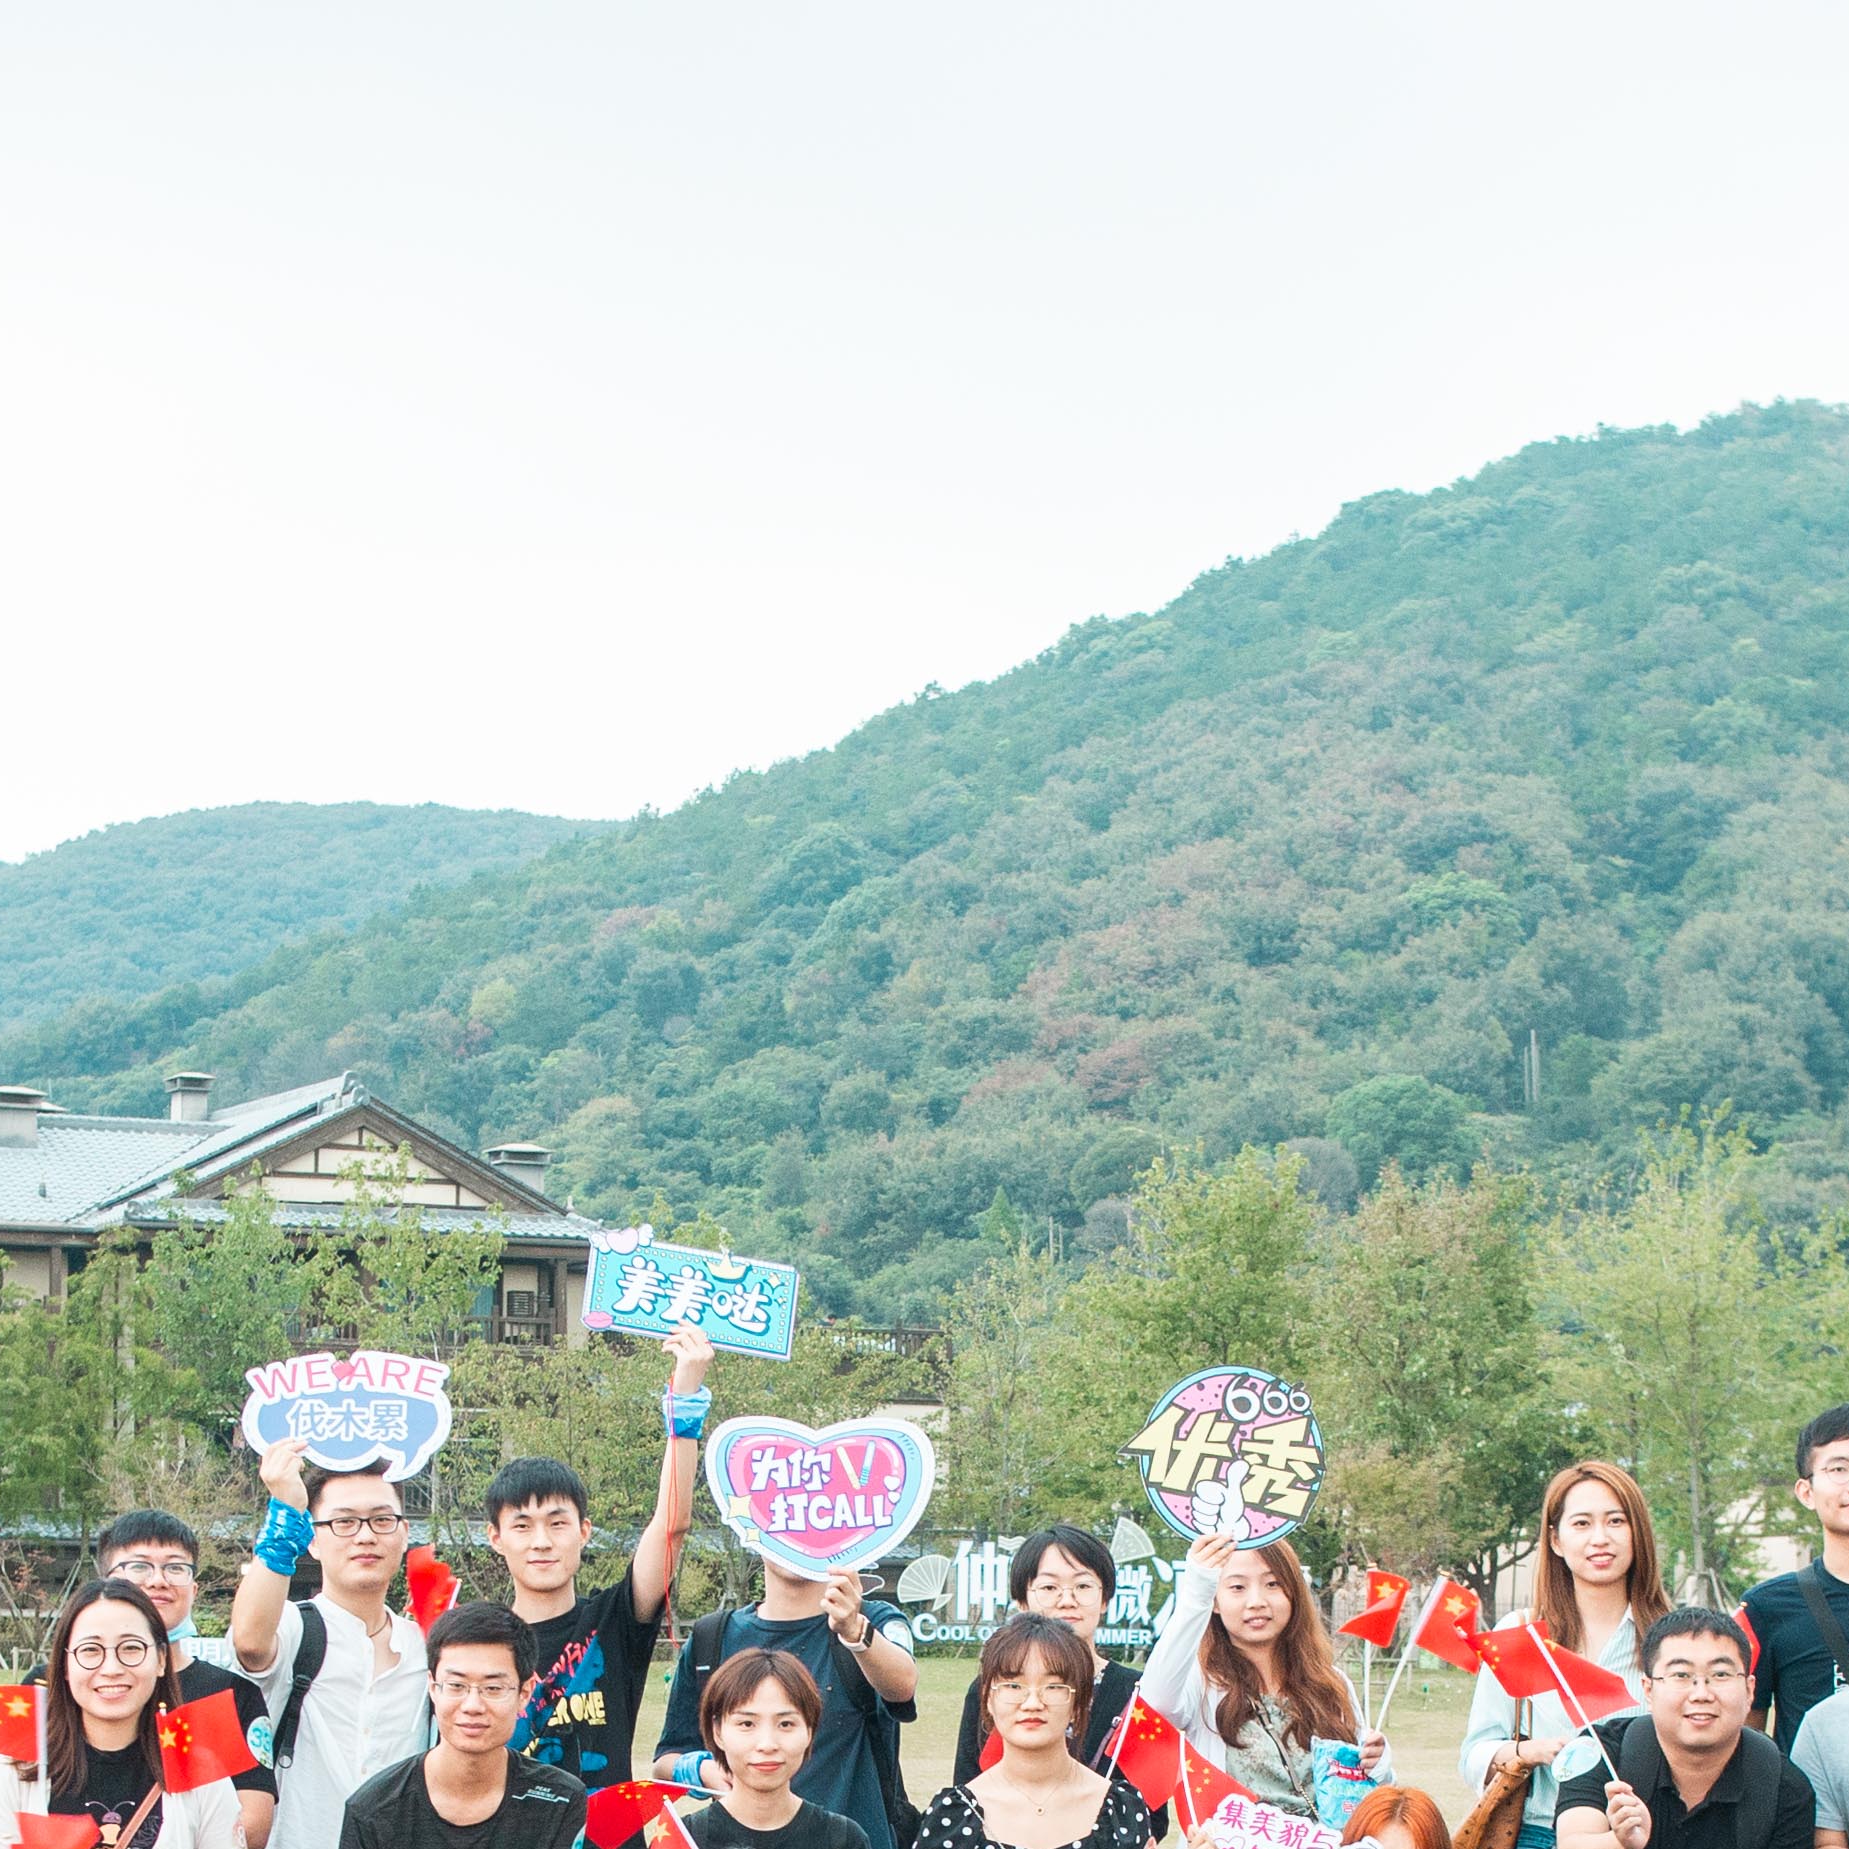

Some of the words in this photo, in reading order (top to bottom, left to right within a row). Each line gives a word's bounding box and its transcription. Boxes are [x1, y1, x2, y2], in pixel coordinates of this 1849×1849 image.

[612, 1255, 771, 1335] 美美哒
[253, 1359, 331, 1398] WE
[345, 1357, 443, 1397] ARE
[1223, 1373, 1312, 1422] 666
[288, 1400, 405, 1441] 伐木累
[750, 1446, 832, 1491] 为你
[1124, 1404, 1322, 1517] 优秀
[766, 1492, 893, 1532] 打CALL
[1094, 1628, 1153, 1645] MMER
